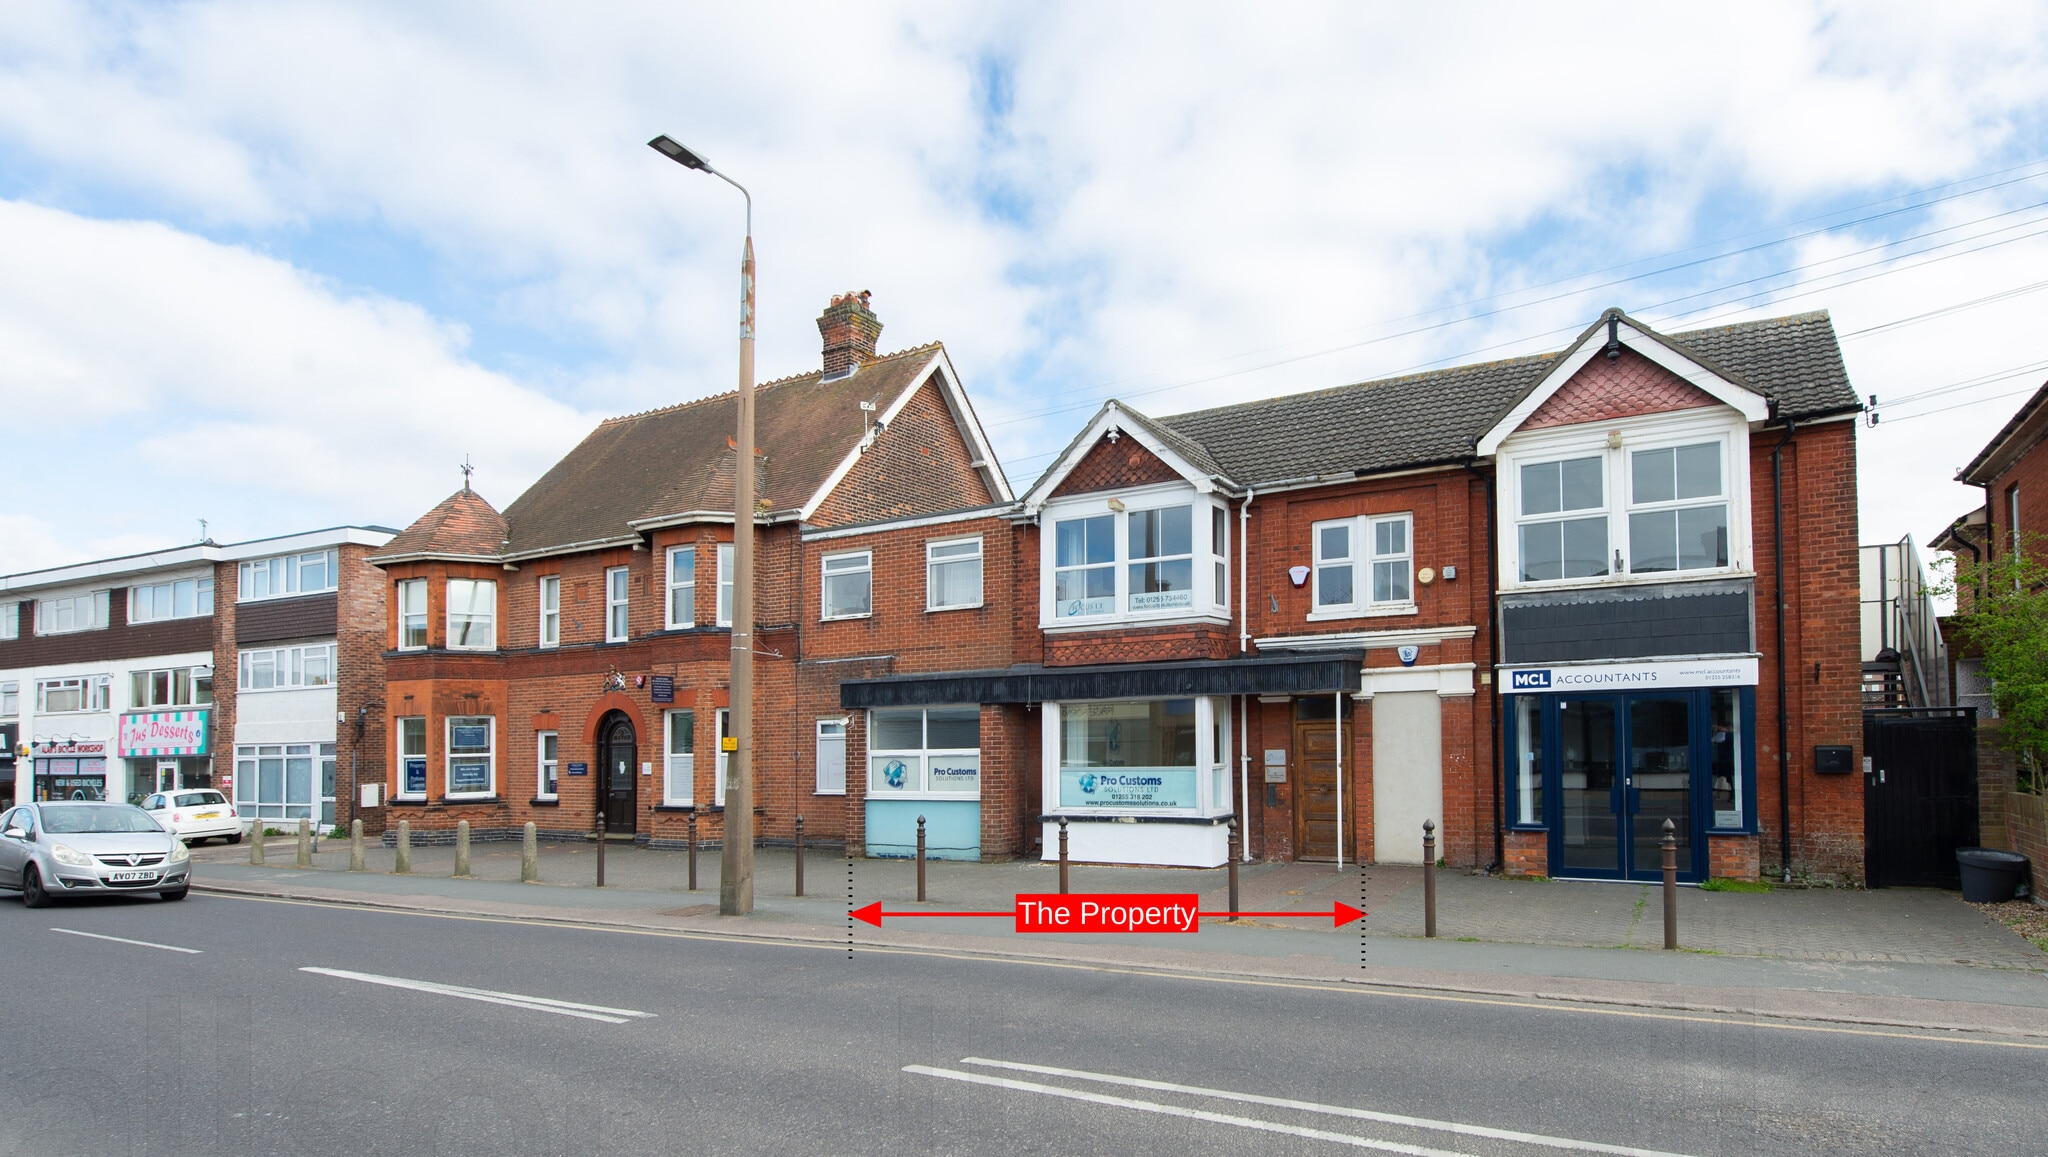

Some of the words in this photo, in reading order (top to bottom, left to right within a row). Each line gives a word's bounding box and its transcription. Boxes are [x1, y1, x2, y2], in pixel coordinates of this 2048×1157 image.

[1515, 673, 1549, 686] MCL
[1556, 671, 1657, 684] ACCOUNTANTS
[150, 722, 194, 744] Desserts
[58, 745, 76, 753] BICYCLE
[77, 744, 104, 753] WORKSHOP
[934, 768, 945, 776] Pro
[947, 767, 977, 776] Customs
[1100, 775, 1117, 786] Pro
[1119, 775, 1162, 786] Customs
